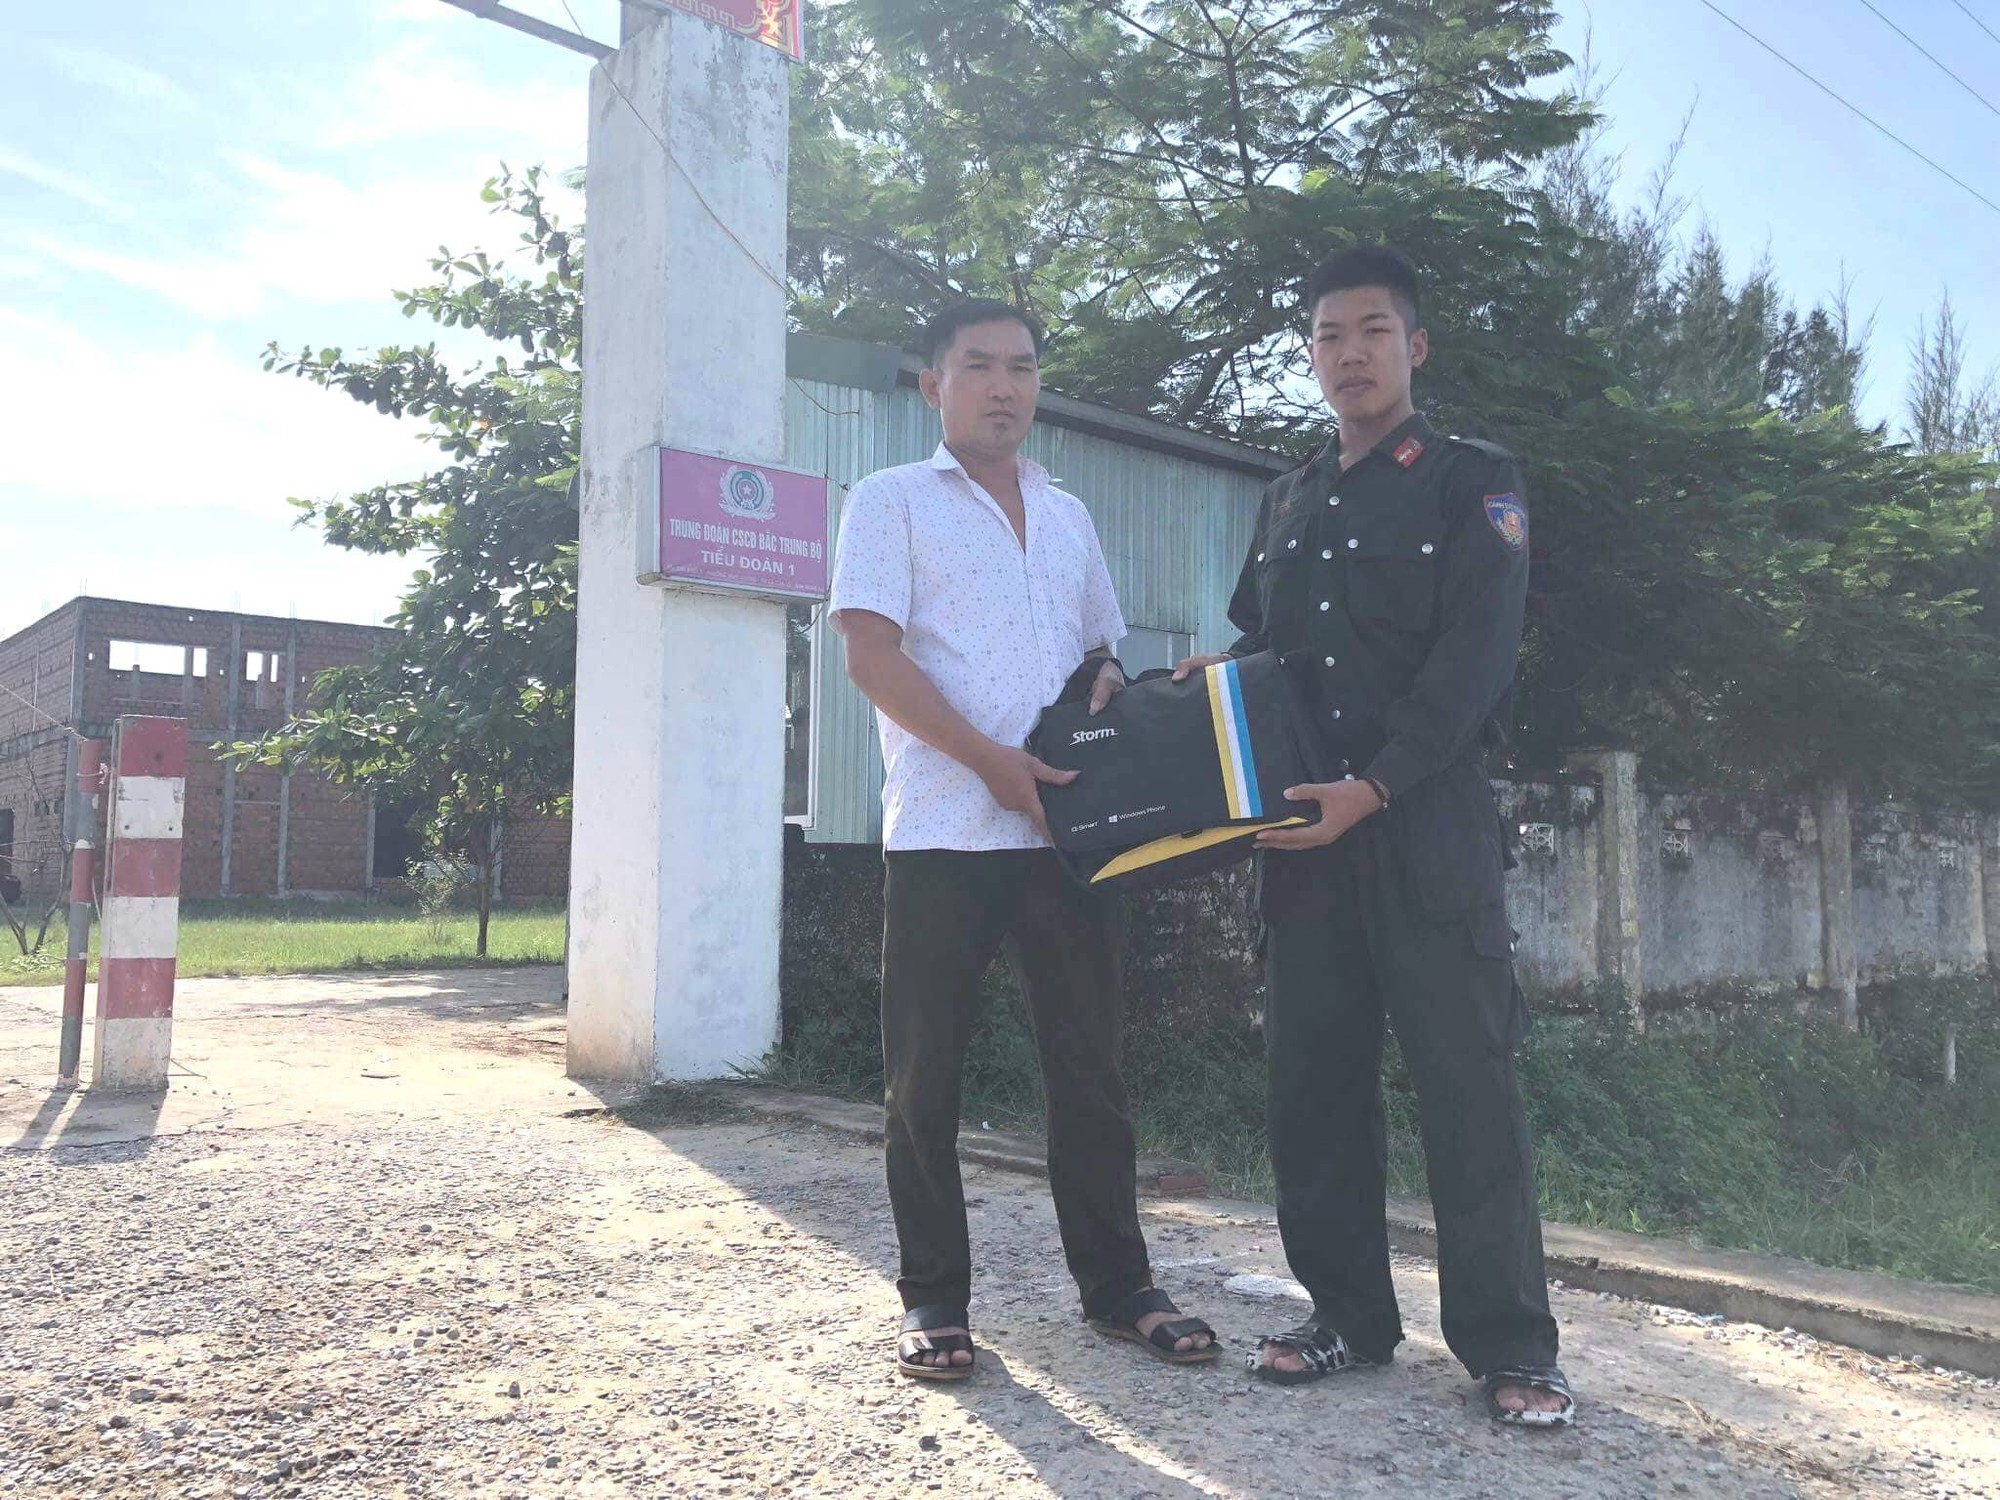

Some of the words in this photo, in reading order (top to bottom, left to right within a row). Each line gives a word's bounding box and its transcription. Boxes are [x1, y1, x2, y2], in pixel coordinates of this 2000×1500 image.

[669, 518, 701, 540] TRUNG
[732, 530, 757, 550] CSCĐ
[778, 536, 809, 559] TRUNG
[701, 546, 735, 567] TIỂU
[739, 557, 783, 575] ĐOÀN
[788, 564, 796, 576] 1
[1070, 728, 1118, 745] Storm
[1118, 810, 1146, 820] Windows
[1146, 805, 1166, 813] Phone
